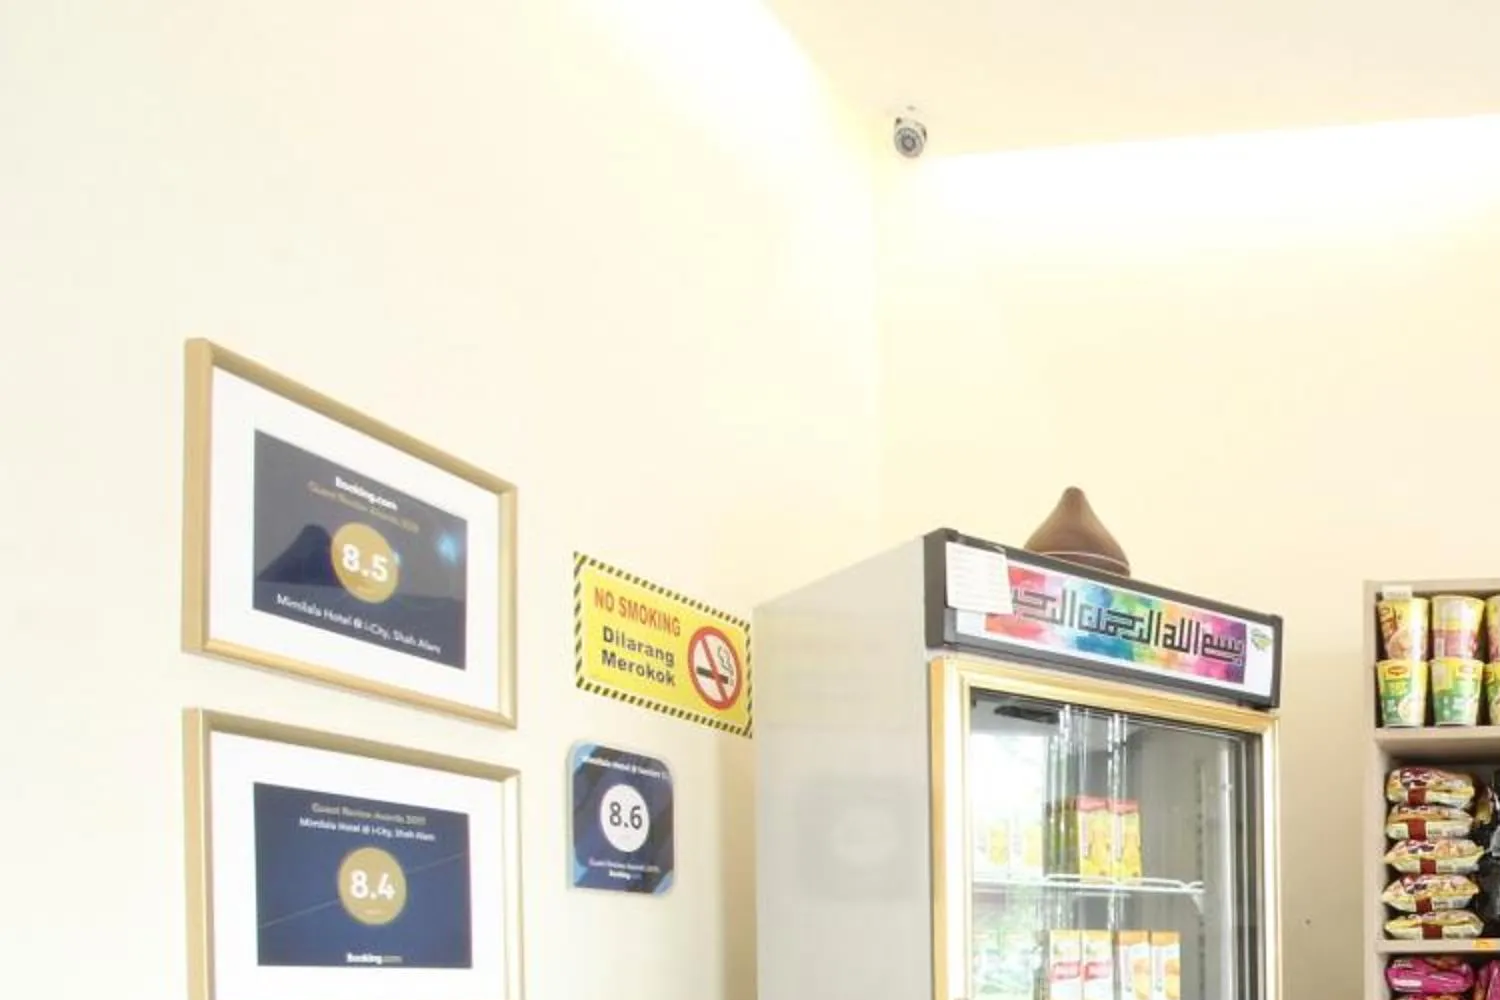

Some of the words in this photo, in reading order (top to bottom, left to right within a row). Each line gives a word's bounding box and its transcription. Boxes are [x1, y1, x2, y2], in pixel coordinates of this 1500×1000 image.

[342, 542, 388, 582] 8.5
[323, 608, 352, 626] Hotel
[594, 586, 614, 613] NO
[618, 596, 681, 637] SMOKING
[603, 626, 675, 668] Dilarang
[601, 649, 677, 687] Merokok
[608, 801, 643, 831] 8.6
[350, 869, 397, 901] 8.4
